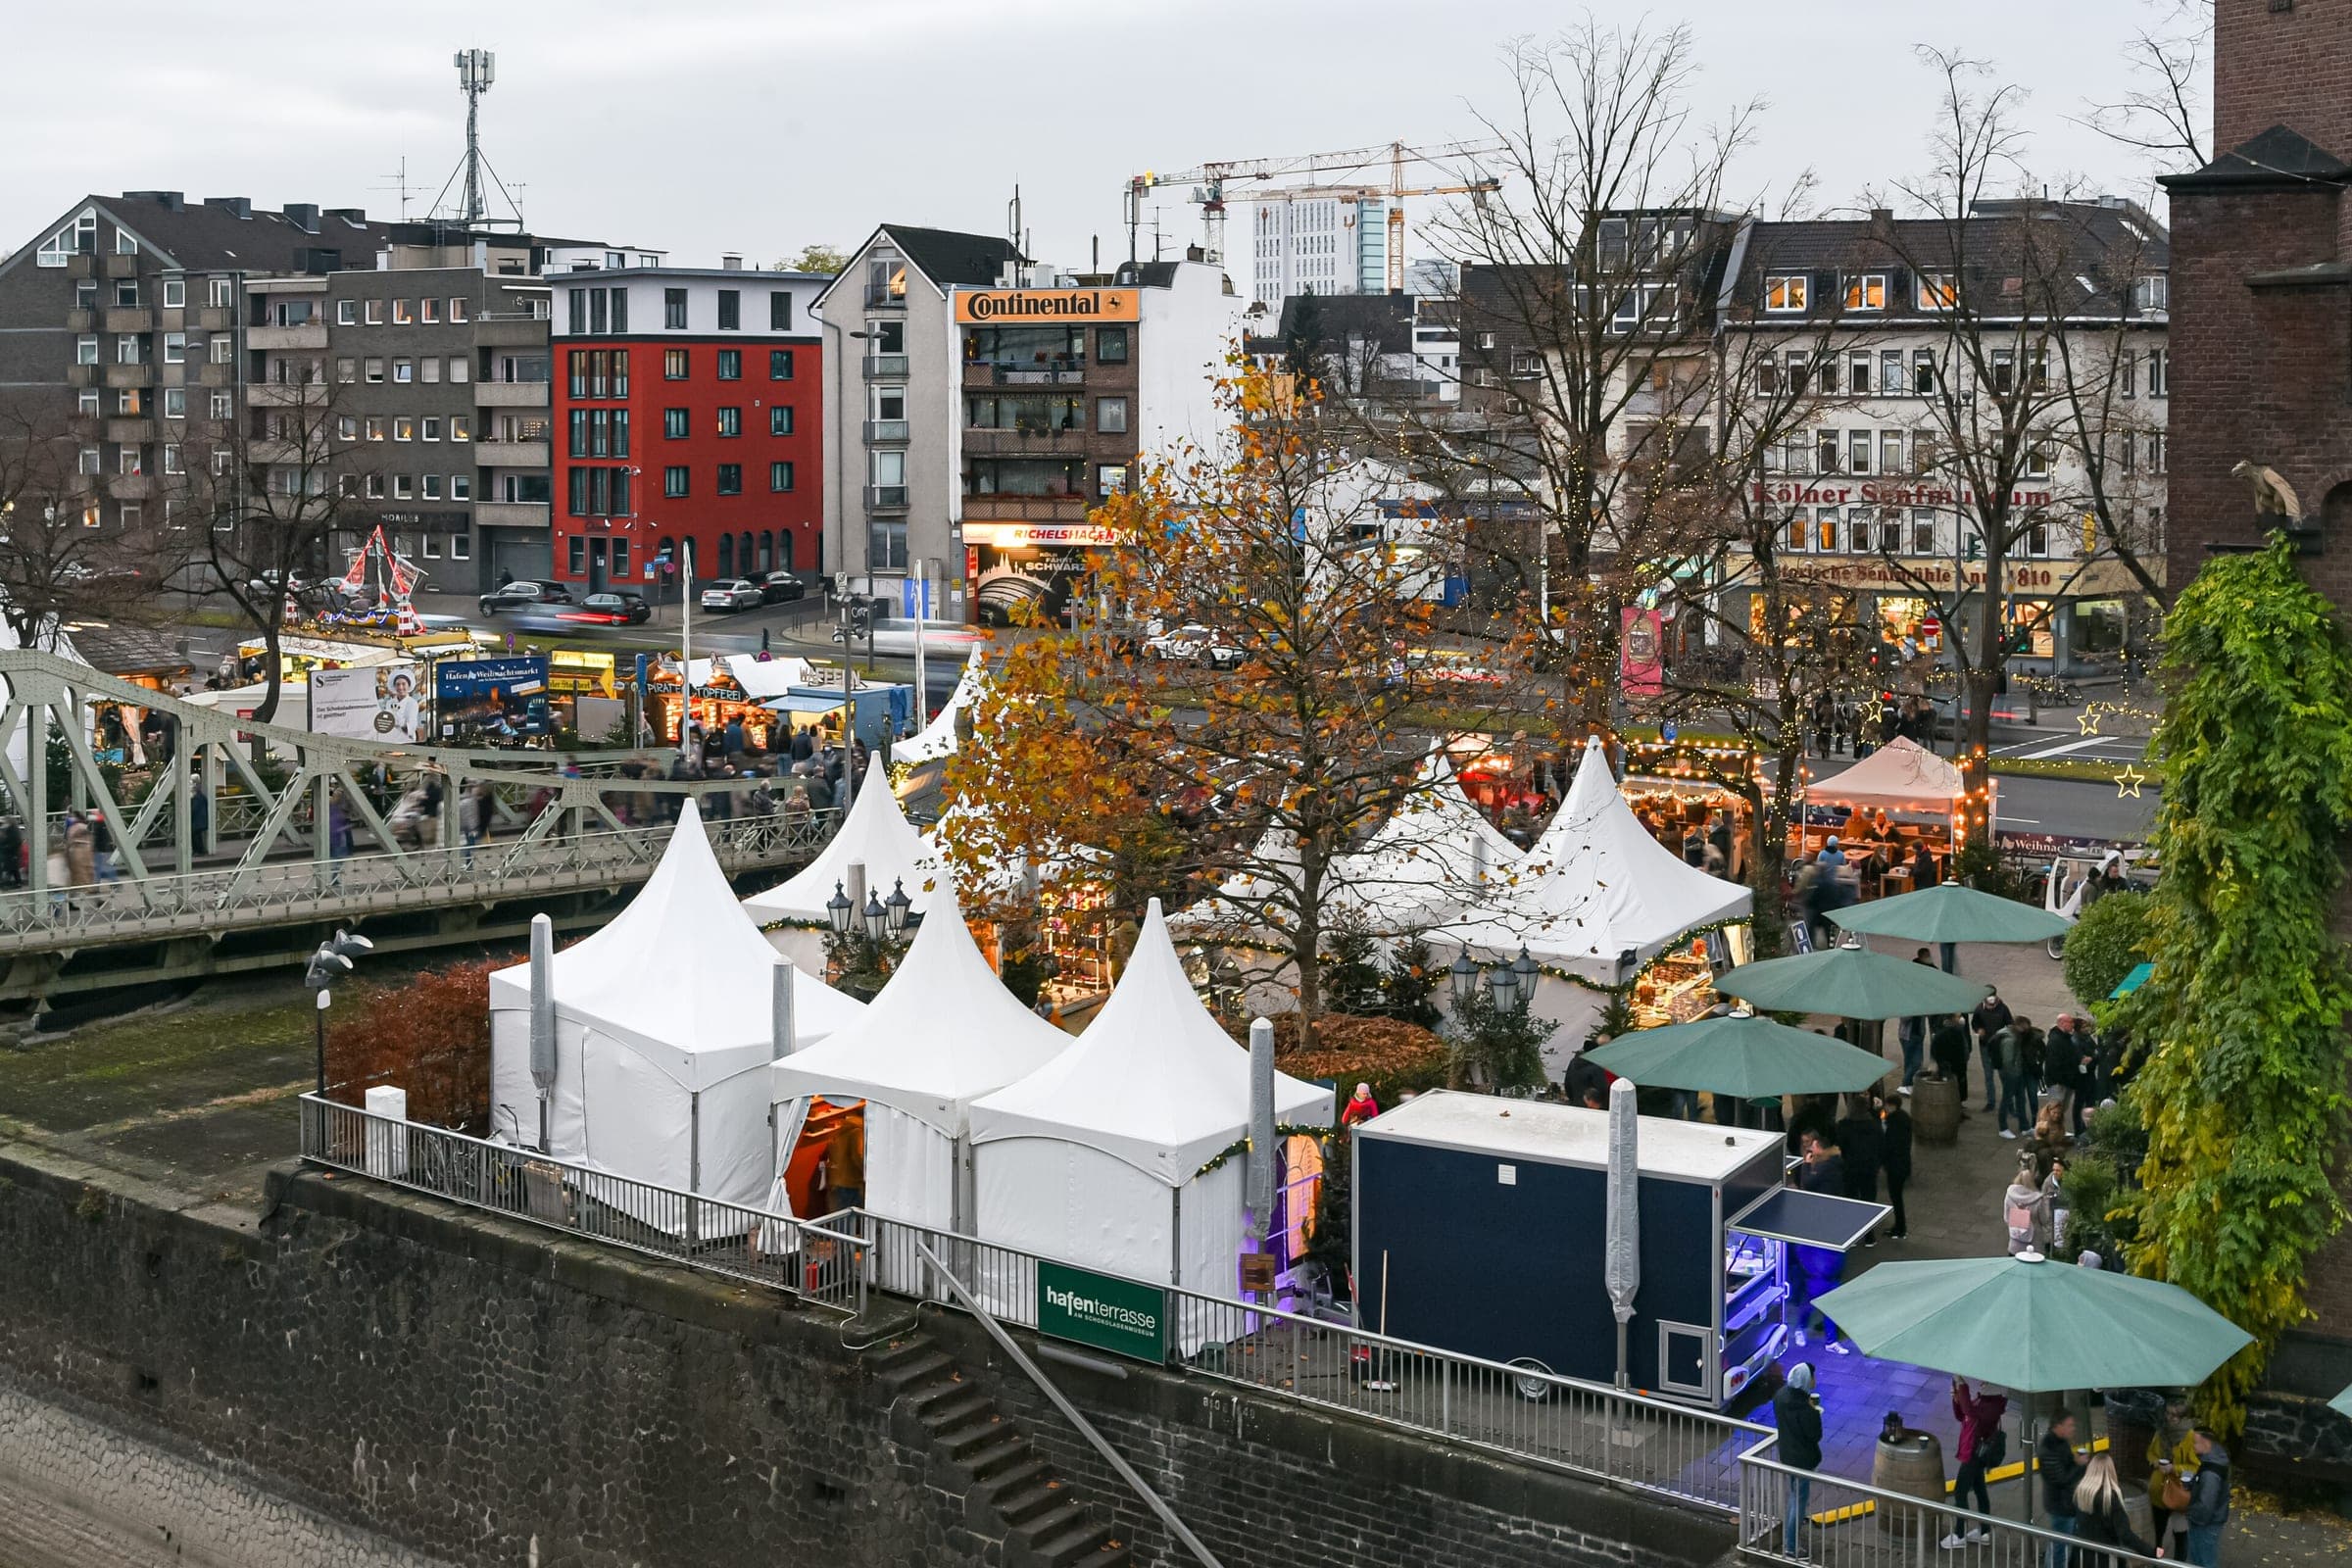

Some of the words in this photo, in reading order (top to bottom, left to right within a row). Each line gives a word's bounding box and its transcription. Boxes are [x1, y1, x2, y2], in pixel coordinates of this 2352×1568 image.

[967, 292, 1101, 320] Continental
[1752, 482, 1851, 504] Kölner
[1014, 528, 1116, 541] RICHELSHAGEN
[445, 672, 467, 681] Hafen
[476, 667, 539, 680] Weihnachtsmarkt
[1046, 1285, 1156, 1330] hafenterrasse
[1074, 1311, 1083, 1320] AM
[1084, 1314, 1155, 1339] SCHOKOLADENMUSEUM
